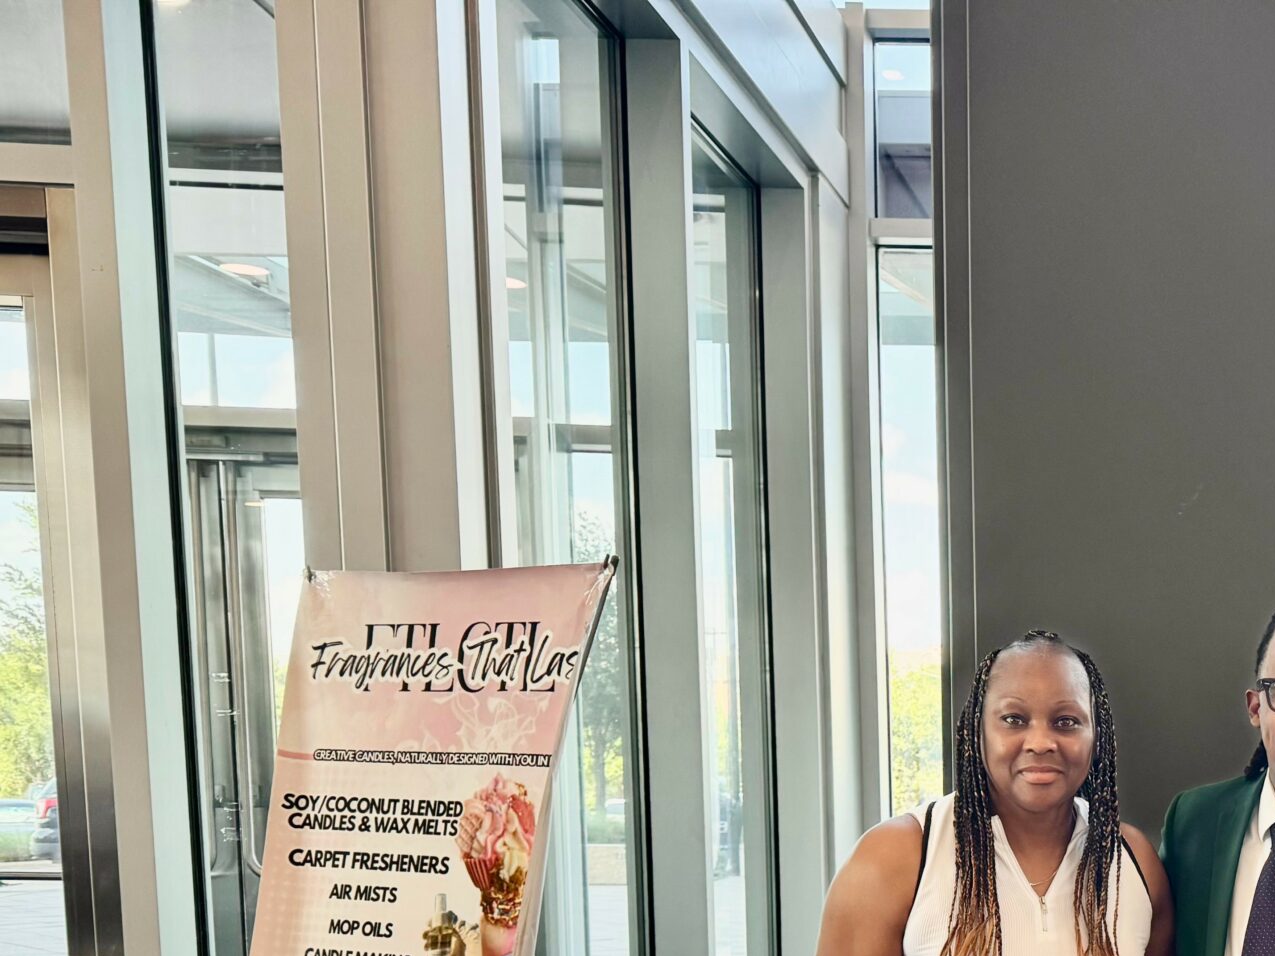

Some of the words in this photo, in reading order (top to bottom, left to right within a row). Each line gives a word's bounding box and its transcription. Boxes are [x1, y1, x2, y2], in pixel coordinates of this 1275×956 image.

[311, 640, 452, 688] Fragrances
[466, 637, 527, 682] That
[531, 635, 579, 682] Las
[313, 749, 355, 762] CREATIVE
[355, 750, 398, 765] CANDLES,
[398, 751, 448, 764] NATURALLY
[448, 752, 489, 765] DESIGNED
[489, 753, 514, 766] WITH
[515, 754, 537, 767] YOU
[538, 755, 549, 767] IN
[281, 793, 400, 815] SOY/COCONUT
[401, 799, 464, 818] BLENDED
[288, 813, 356, 832] CANDLES
[358, 816, 371, 833] &
[375, 817, 411, 834] WAX
[412, 818, 459, 836] MELTS
[288, 848, 350, 868] CARPET
[351, 852, 450, 875] FRESHENERS
[328, 884, 353, 902] AIR
[355, 886, 398, 905] MISTS
[328, 919, 361, 935] MOP
[362, 921, 394, 938] OILS
